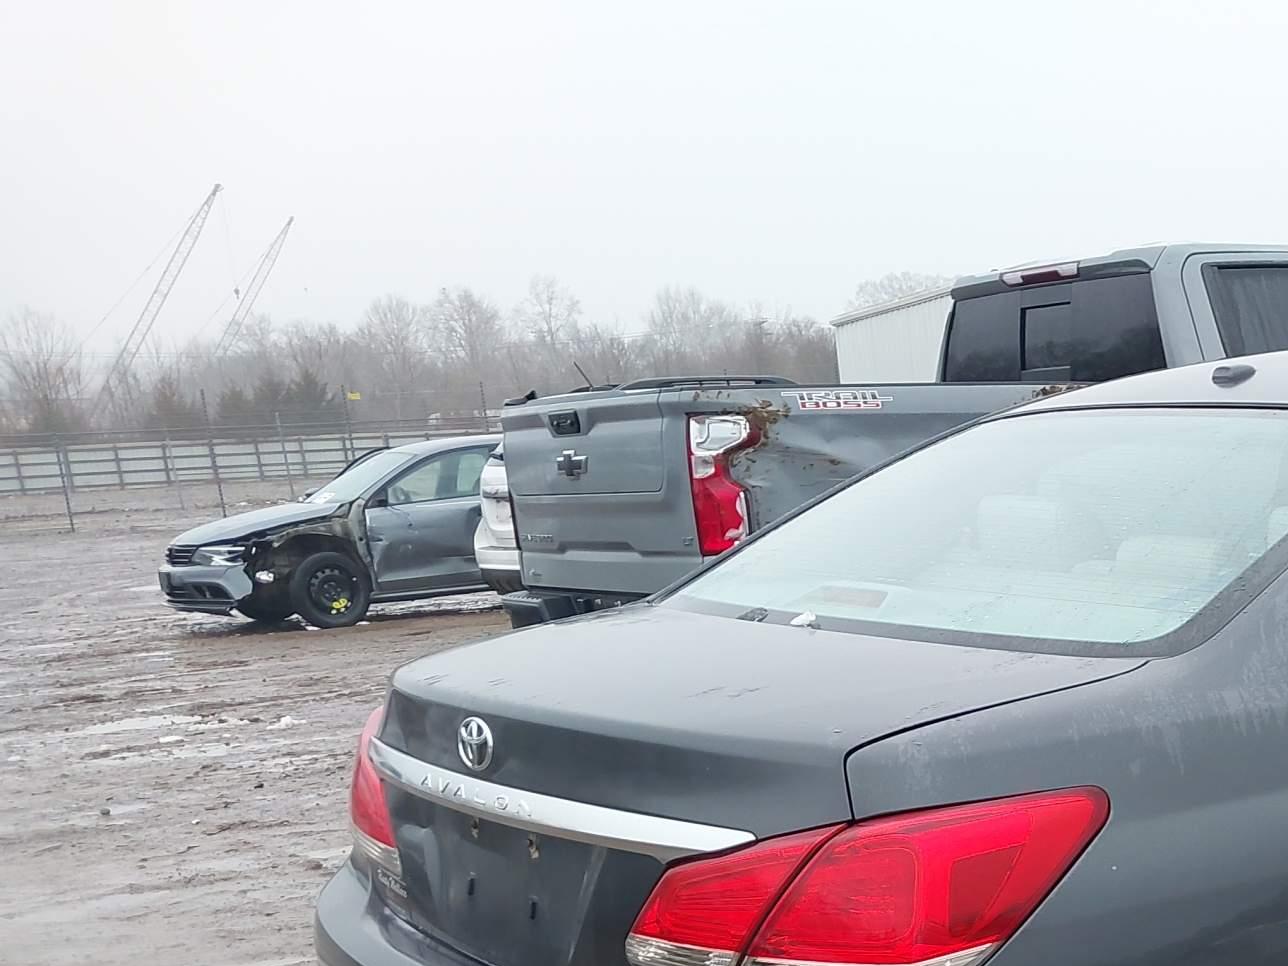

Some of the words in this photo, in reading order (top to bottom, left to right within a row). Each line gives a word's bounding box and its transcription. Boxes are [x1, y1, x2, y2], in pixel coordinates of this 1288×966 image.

[781, 390, 893, 401] TRAIL
[799, 400, 882, 410] BOSS
[420, 773, 532, 817] AVALON
